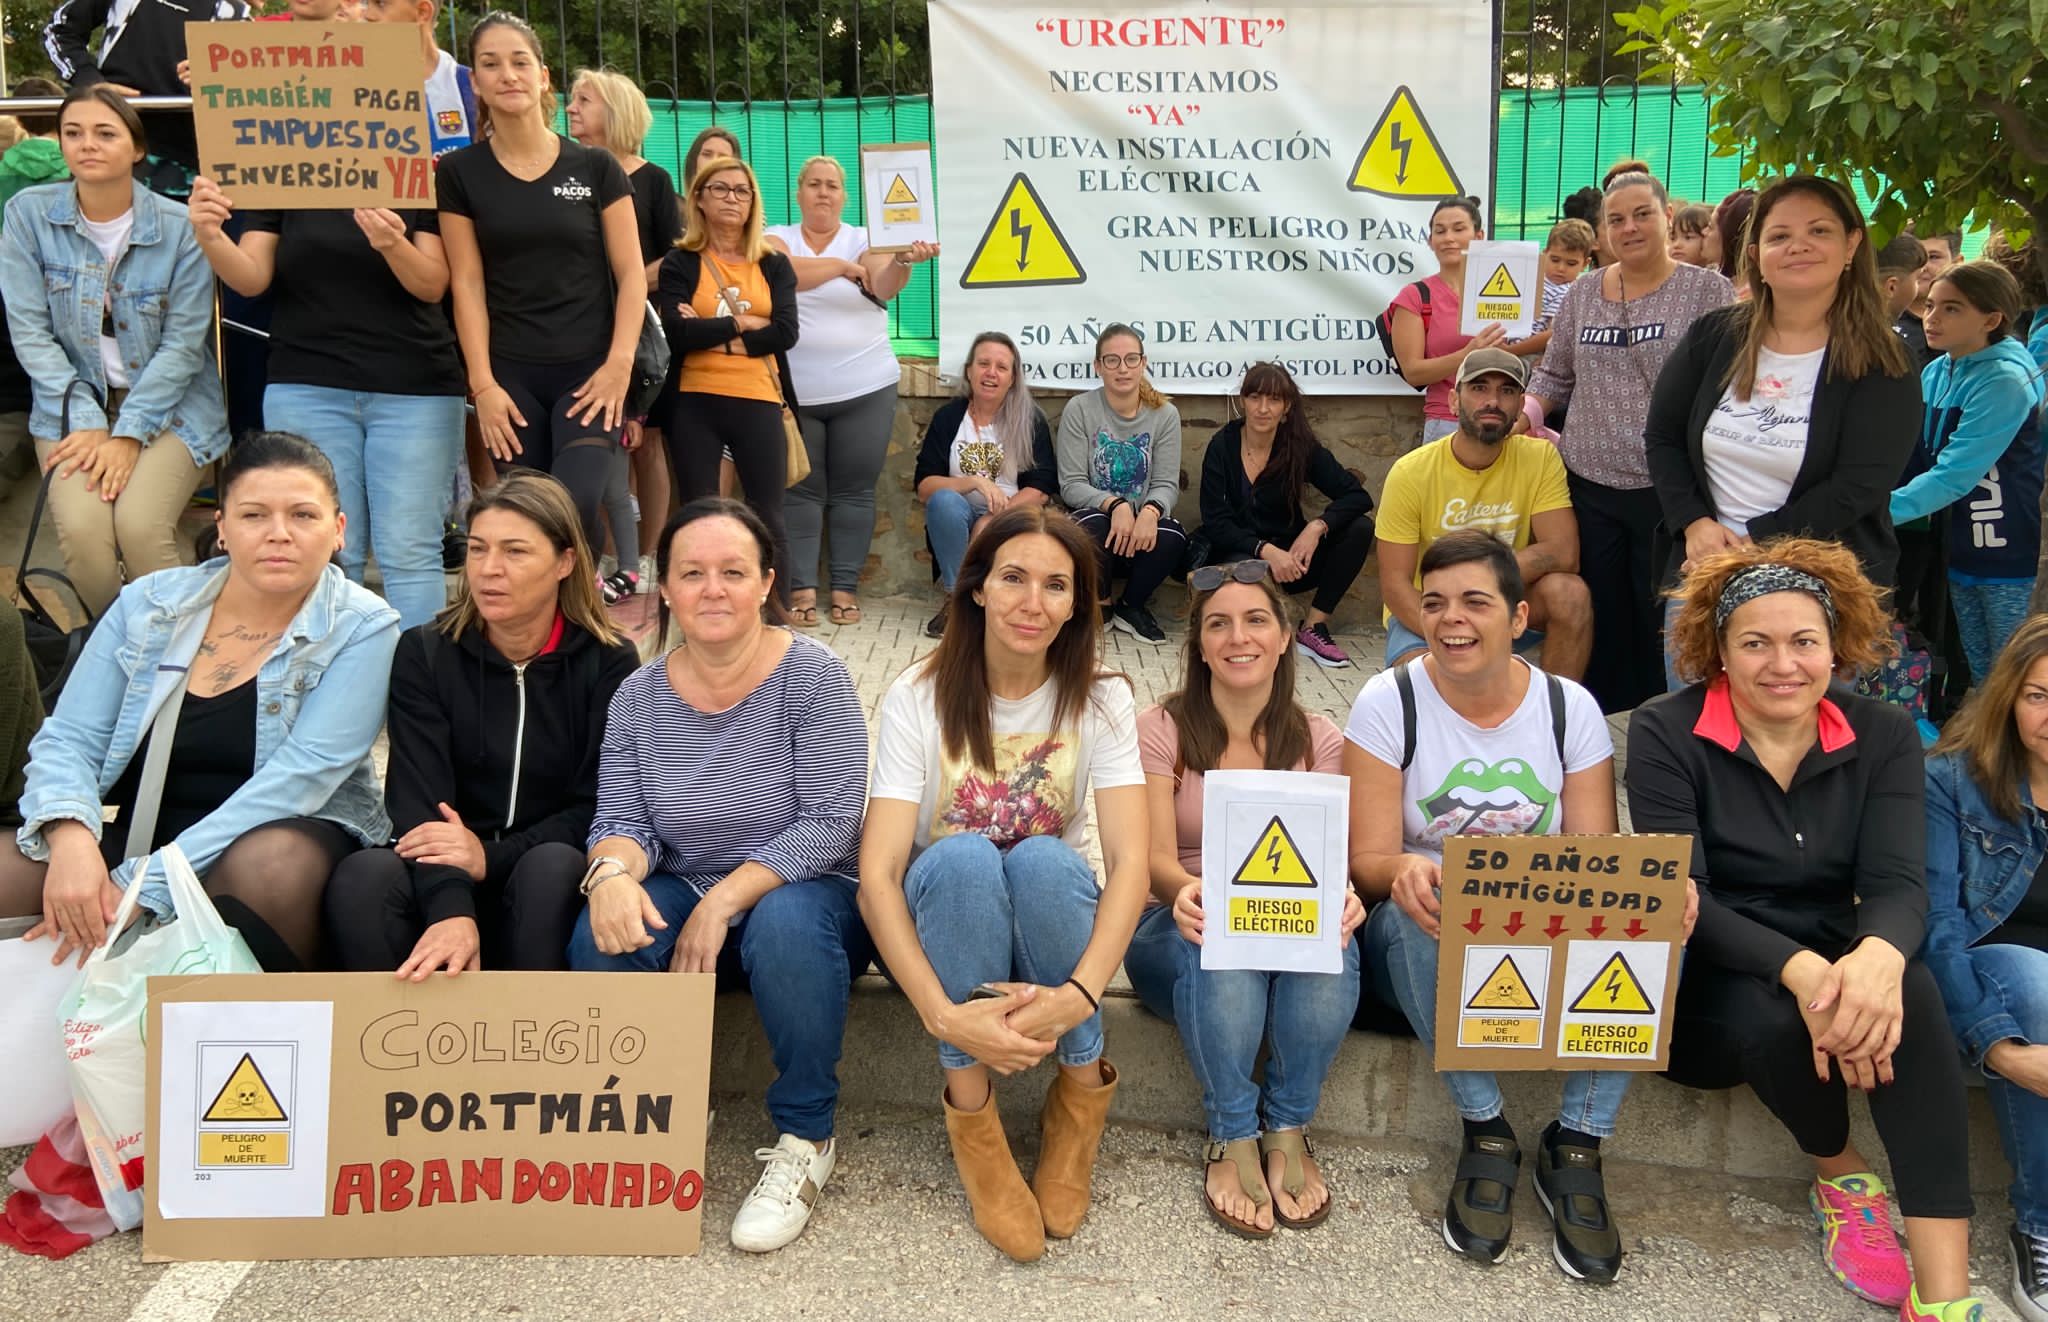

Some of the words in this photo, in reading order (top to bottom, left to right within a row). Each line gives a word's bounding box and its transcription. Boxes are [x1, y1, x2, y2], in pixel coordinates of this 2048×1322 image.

[1036, 17, 1286, 48] “URGENTE”
[208, 32, 364, 72] PORTMÁN
[1048, 69, 1279, 93] NECESITAMOS
[354, 88, 421, 112] PAGA
[232, 118, 421, 155] IMPUESTOS
[1002, 136, 1108, 160] NUEVA
[1117, 130, 1332, 161] INSTALACIÓN
[384, 156, 429, 200] YA
[1078, 165, 1261, 193] ELÉCTRICA
[553, 186, 592, 197] PACOS
[1107, 215, 1198, 239] GRAN
[1207, 216, 1349, 241] PELIGRO
[1359, 218, 1432, 245] PARA
[1140, 249, 1309, 273] NUESTROS
[1319, 247, 1415, 275] NIÑOS
[1478, 311, 1519, 320] ELÉCTRICO
[1020, 325, 1050, 345] 50
[1059, 317, 1146, 345] AÑS
[1156, 320, 1197, 343] DE
[1207, 314, 1381, 343] ANTIGÜED
[1581, 329, 1620, 344] START
[1053, 363, 1100, 379] CEI
[1145, 360, 1232, 379] NTIAGO
[1238, 355, 1346, 376] ASTOL
[1465, 849, 1509, 871] 50
[1529, 847, 1620, 875] AÑOS
[1640, 858, 1679, 881] DE
[1247, 900, 1302, 916] RIESGO
[1234, 914, 1315, 934] ELÉCTRICO
[1481, 1019, 1520, 1027] PELIGRO
[1581, 1025, 1637, 1039] RIESGO
[1482, 1035, 1520, 1043] MUERTE
[1567, 1038, 1648, 1054] ELÉCTRICO
[384, 1075, 673, 1136] PORTMÁN
[222, 1134, 266, 1143] PELIGRO
[238, 1144, 253, 1153] DE
[224, 1154, 267, 1163] MUERTE
[332, 1158, 705, 1217] ABANDONADO
